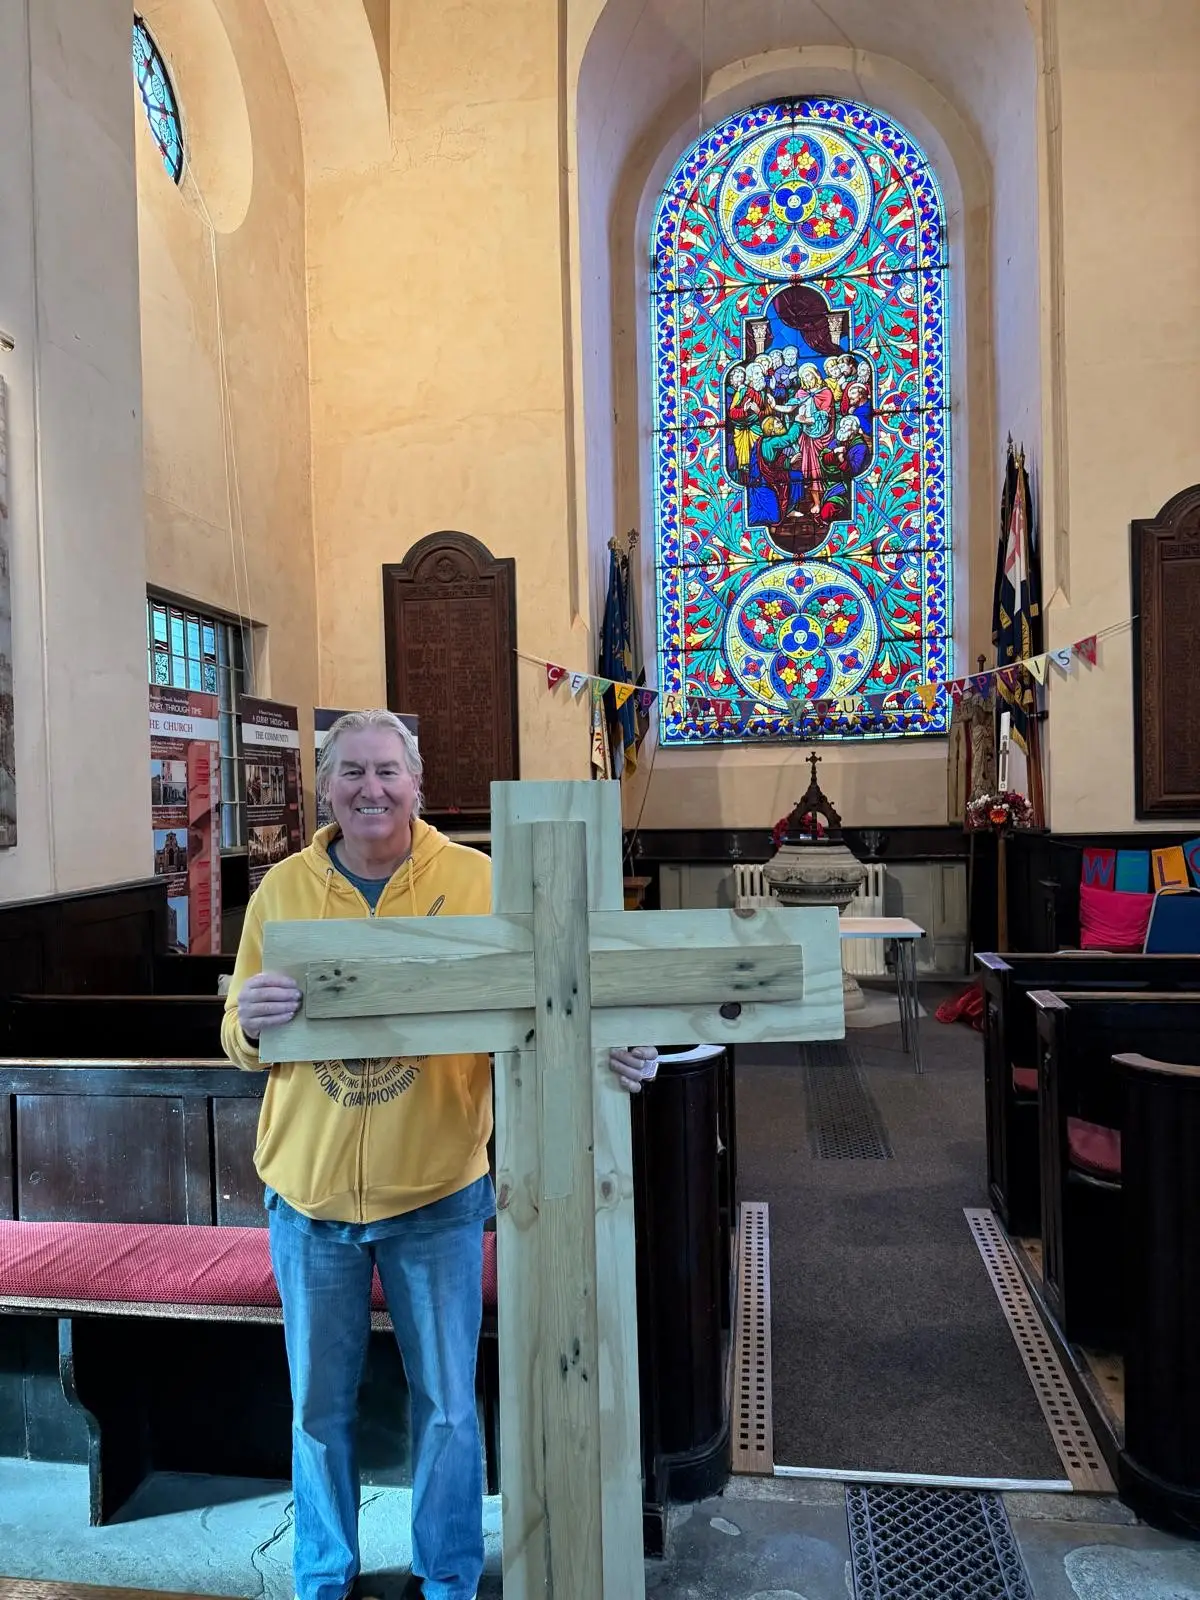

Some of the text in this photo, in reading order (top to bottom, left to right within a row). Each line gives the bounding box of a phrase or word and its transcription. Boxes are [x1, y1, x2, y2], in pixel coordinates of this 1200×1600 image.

[149, 702, 164, 711] RNEY
[149, 719, 193, 733] HE CHURCH
[312, 1061, 421, 1108] ATIONAL CHAMPIONSHIPS
[337, 1070, 359, 1089] RACING
